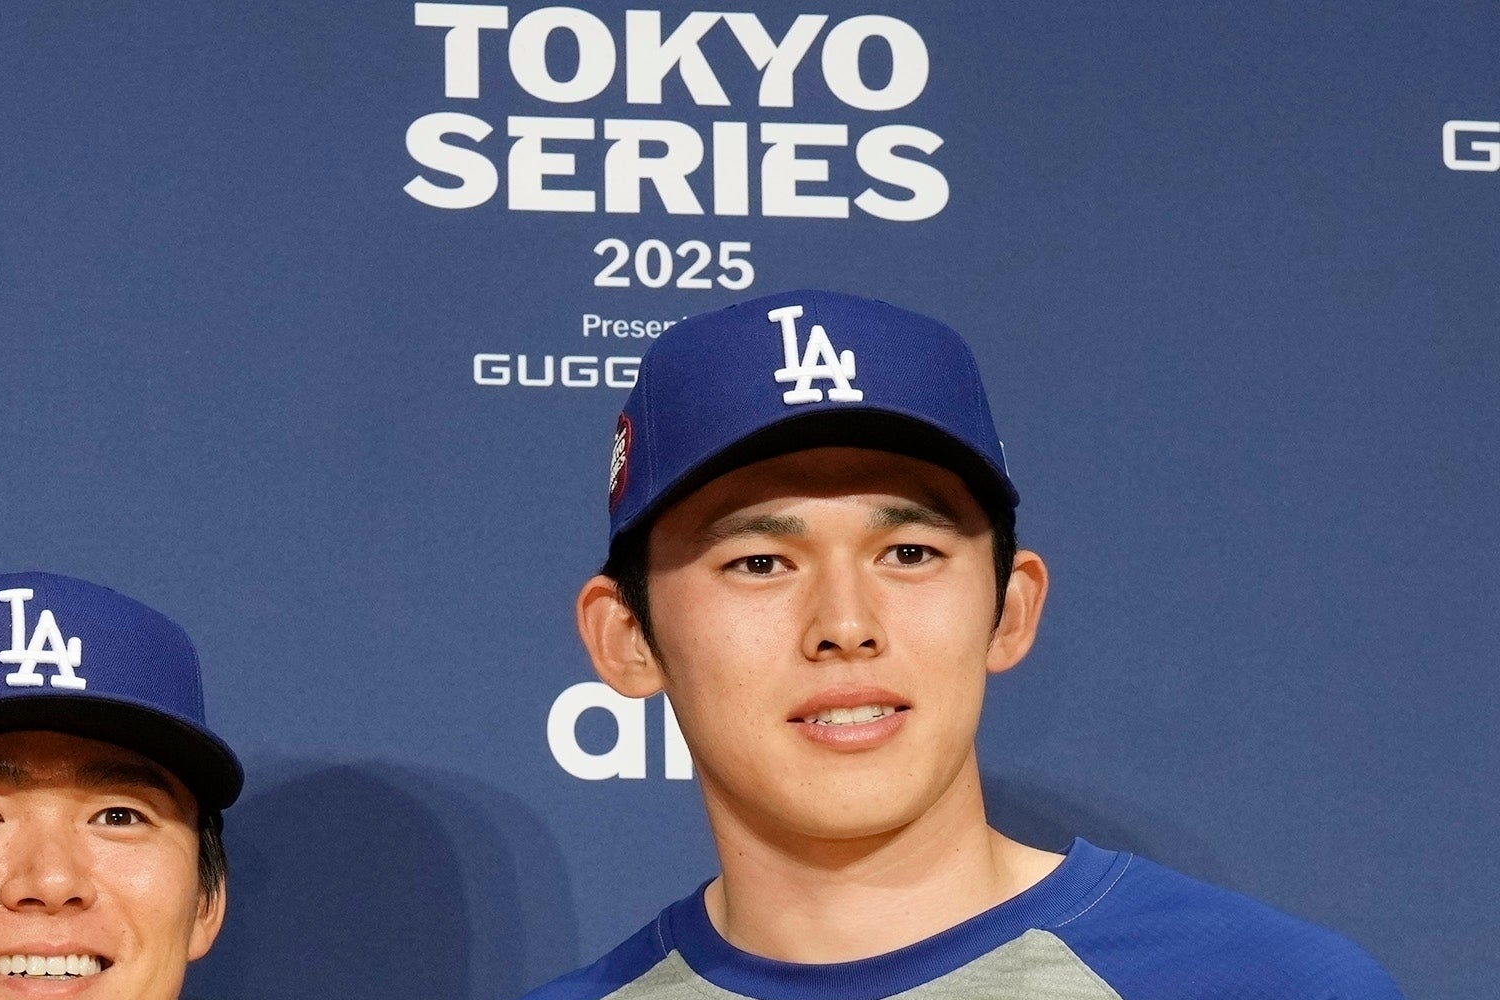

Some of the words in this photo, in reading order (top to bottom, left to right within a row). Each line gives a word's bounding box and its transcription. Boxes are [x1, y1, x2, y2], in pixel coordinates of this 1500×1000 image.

[414, 2, 929, 111] TOKYO
[403, 112, 949, 221] SERIES
[593, 238, 755, 290] 2025
[582, 313, 687, 339] Prese
[768, 305, 863, 405] LA
